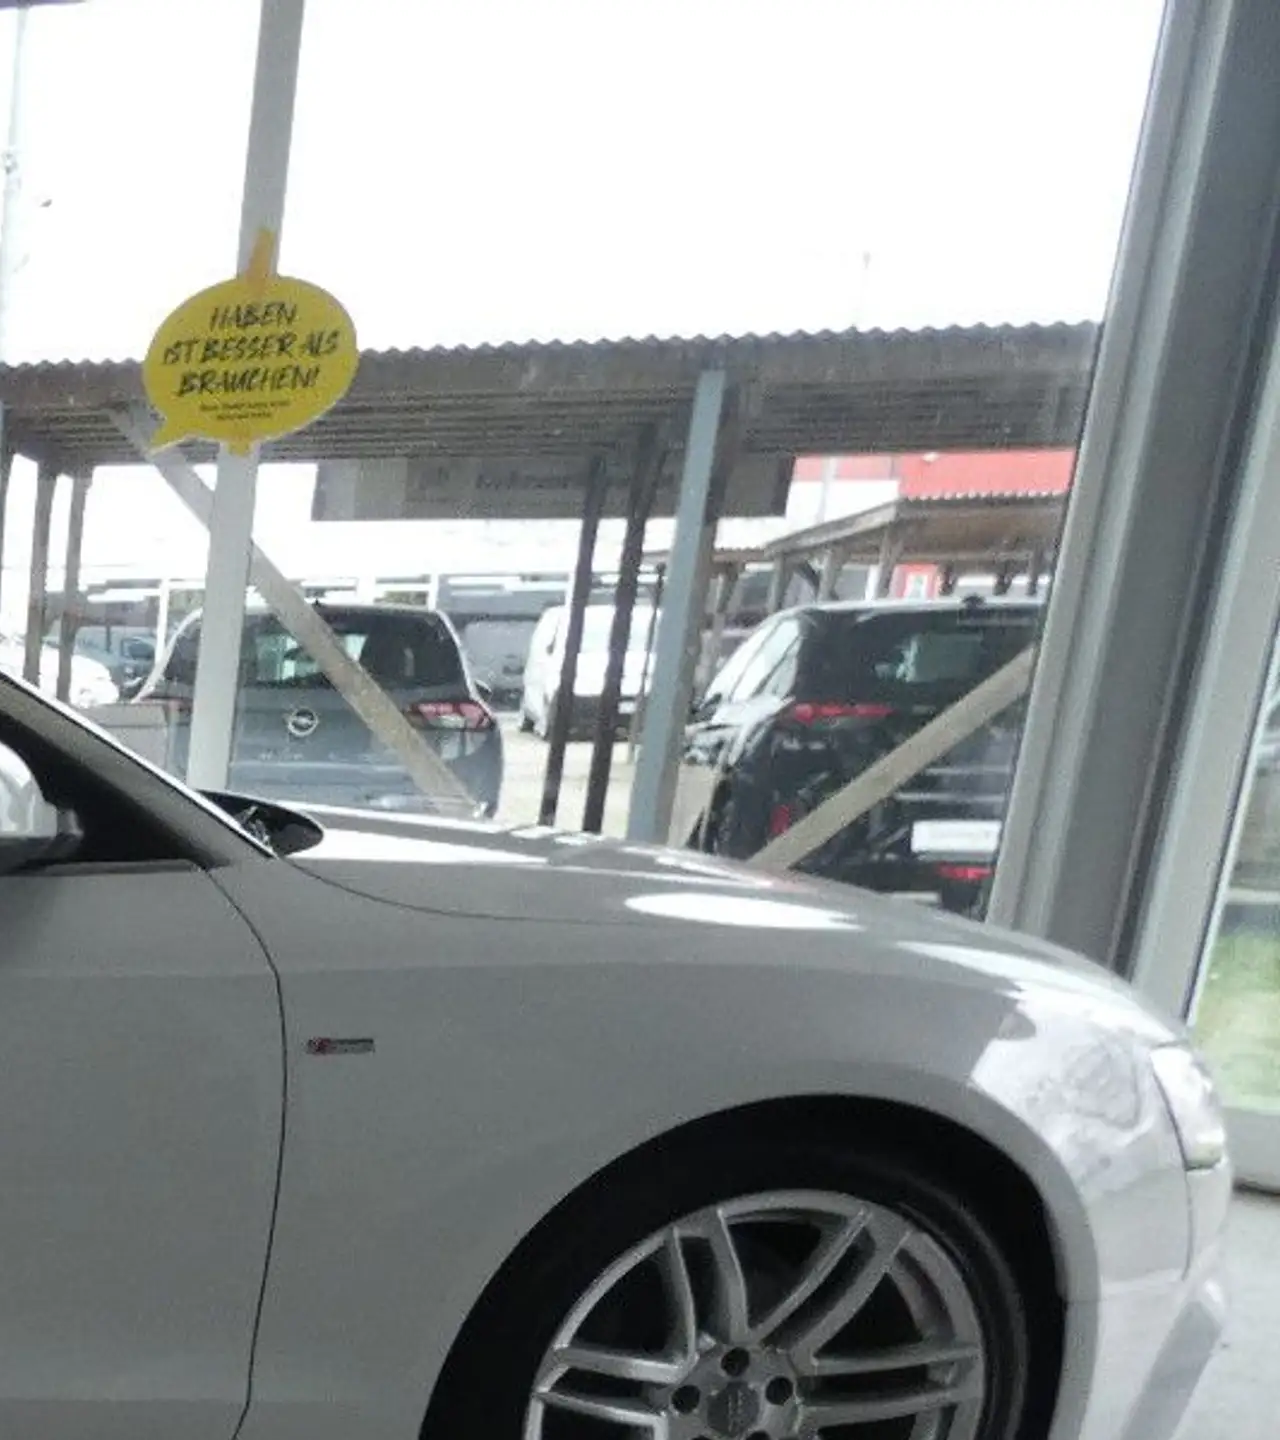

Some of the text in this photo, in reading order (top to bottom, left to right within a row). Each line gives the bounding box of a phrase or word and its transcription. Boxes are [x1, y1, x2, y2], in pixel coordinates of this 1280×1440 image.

[211, 301, 297, 330] HABEN
[163, 330, 341, 365] IST BESSER ALS
[174, 365, 319, 397] BRAUCHEN!
